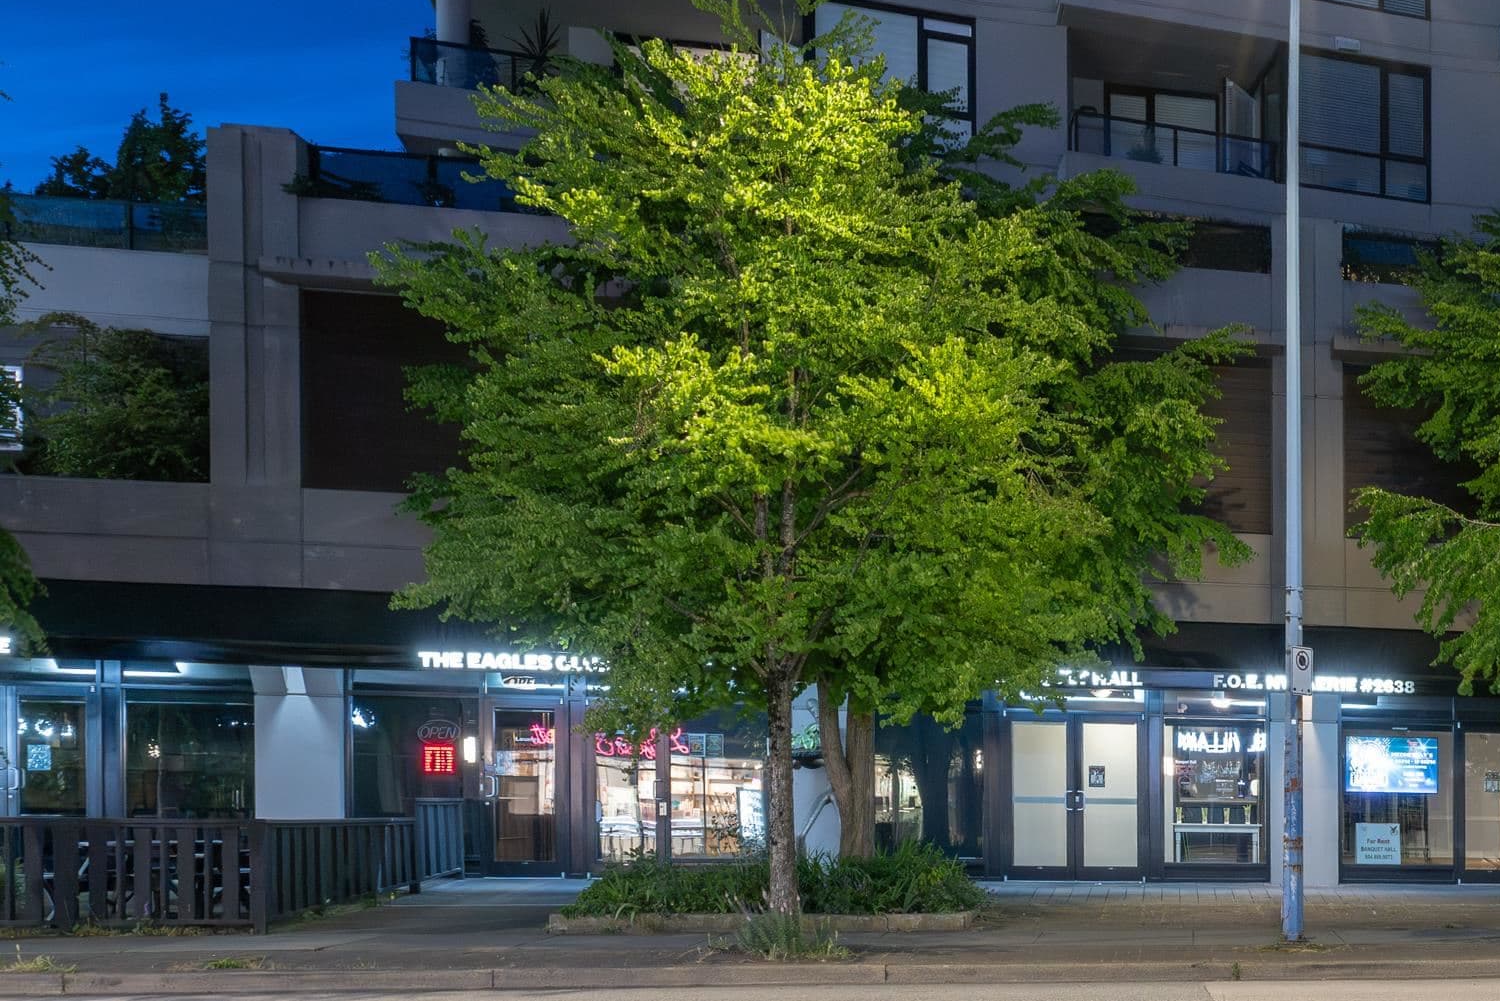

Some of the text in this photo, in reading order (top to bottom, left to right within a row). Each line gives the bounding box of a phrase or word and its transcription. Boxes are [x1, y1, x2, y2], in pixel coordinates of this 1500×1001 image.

[418, 651, 464, 669] THE
[466, 652, 553, 671] EAGLES
[420, 726, 457, 739] OPEN
